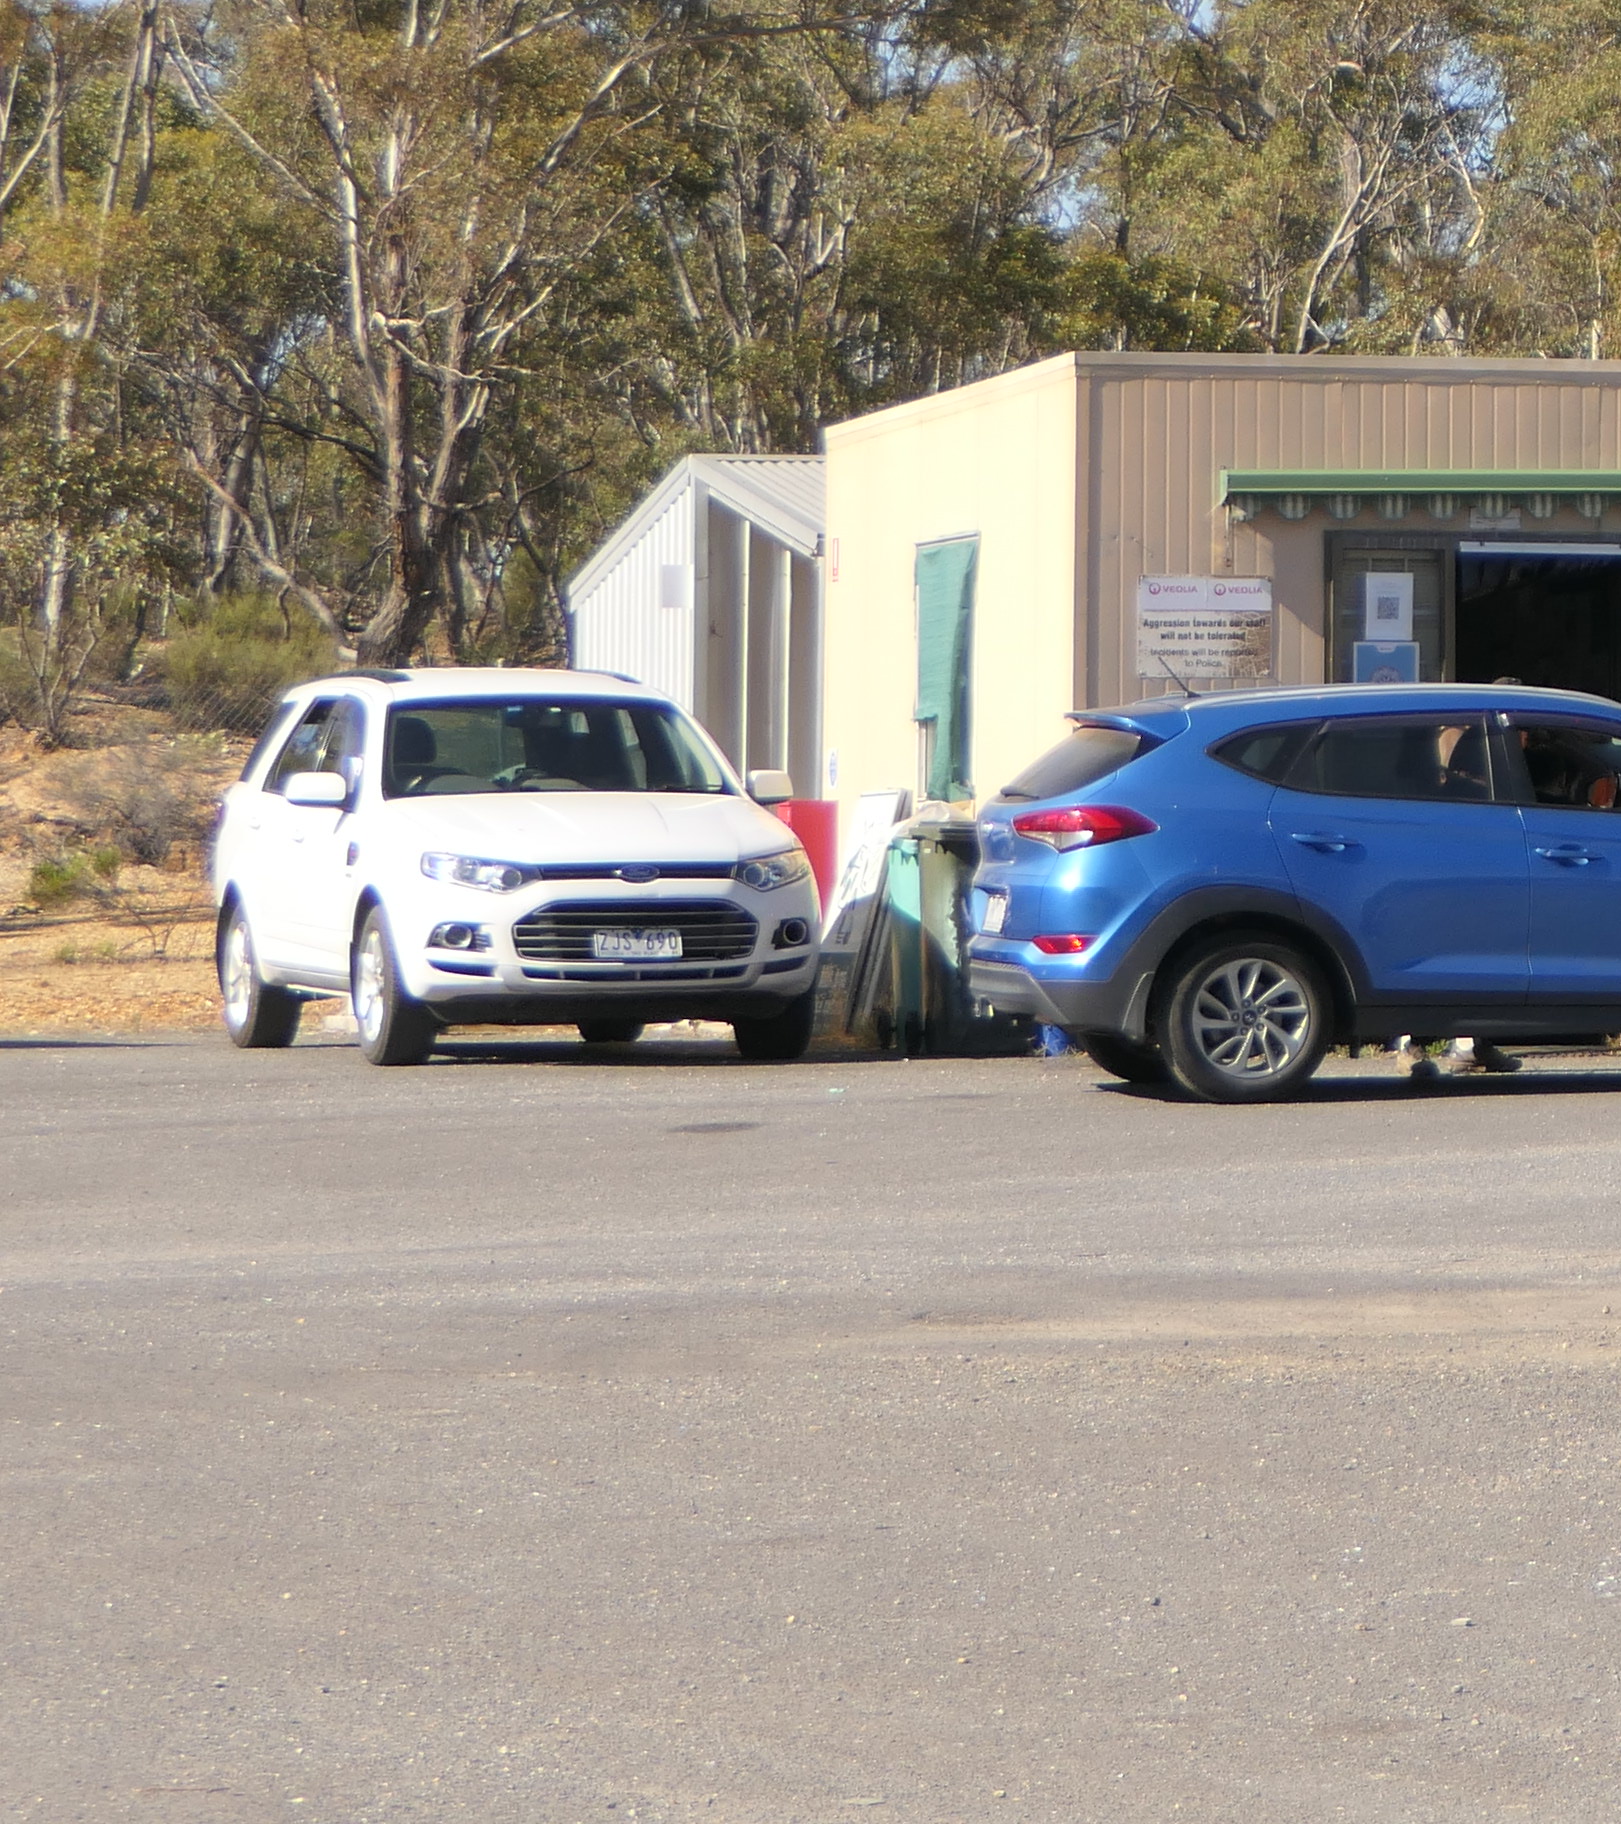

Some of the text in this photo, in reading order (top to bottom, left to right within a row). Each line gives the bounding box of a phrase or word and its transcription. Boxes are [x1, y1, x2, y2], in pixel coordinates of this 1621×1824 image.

[1162, 585, 1198, 593] VEOLIA
[1228, 586, 1262, 594] VEOLIA
[1143, 618, 1190, 629] Aggression
[1193, 617, 1227, 627] towards
[1229, 619, 1243, 627] our
[1160, 631, 1175, 640] will
[1178, 632, 1192, 640] not
[1194, 631, 1205, 640] be
[1150, 648, 1189, 656] Incidents
[1191, 648, 1206, 656] will
[1208, 648, 1219, 656] be
[1185, 659, 1193, 667] to
[598, 932, 677, 950] ZJS 690
